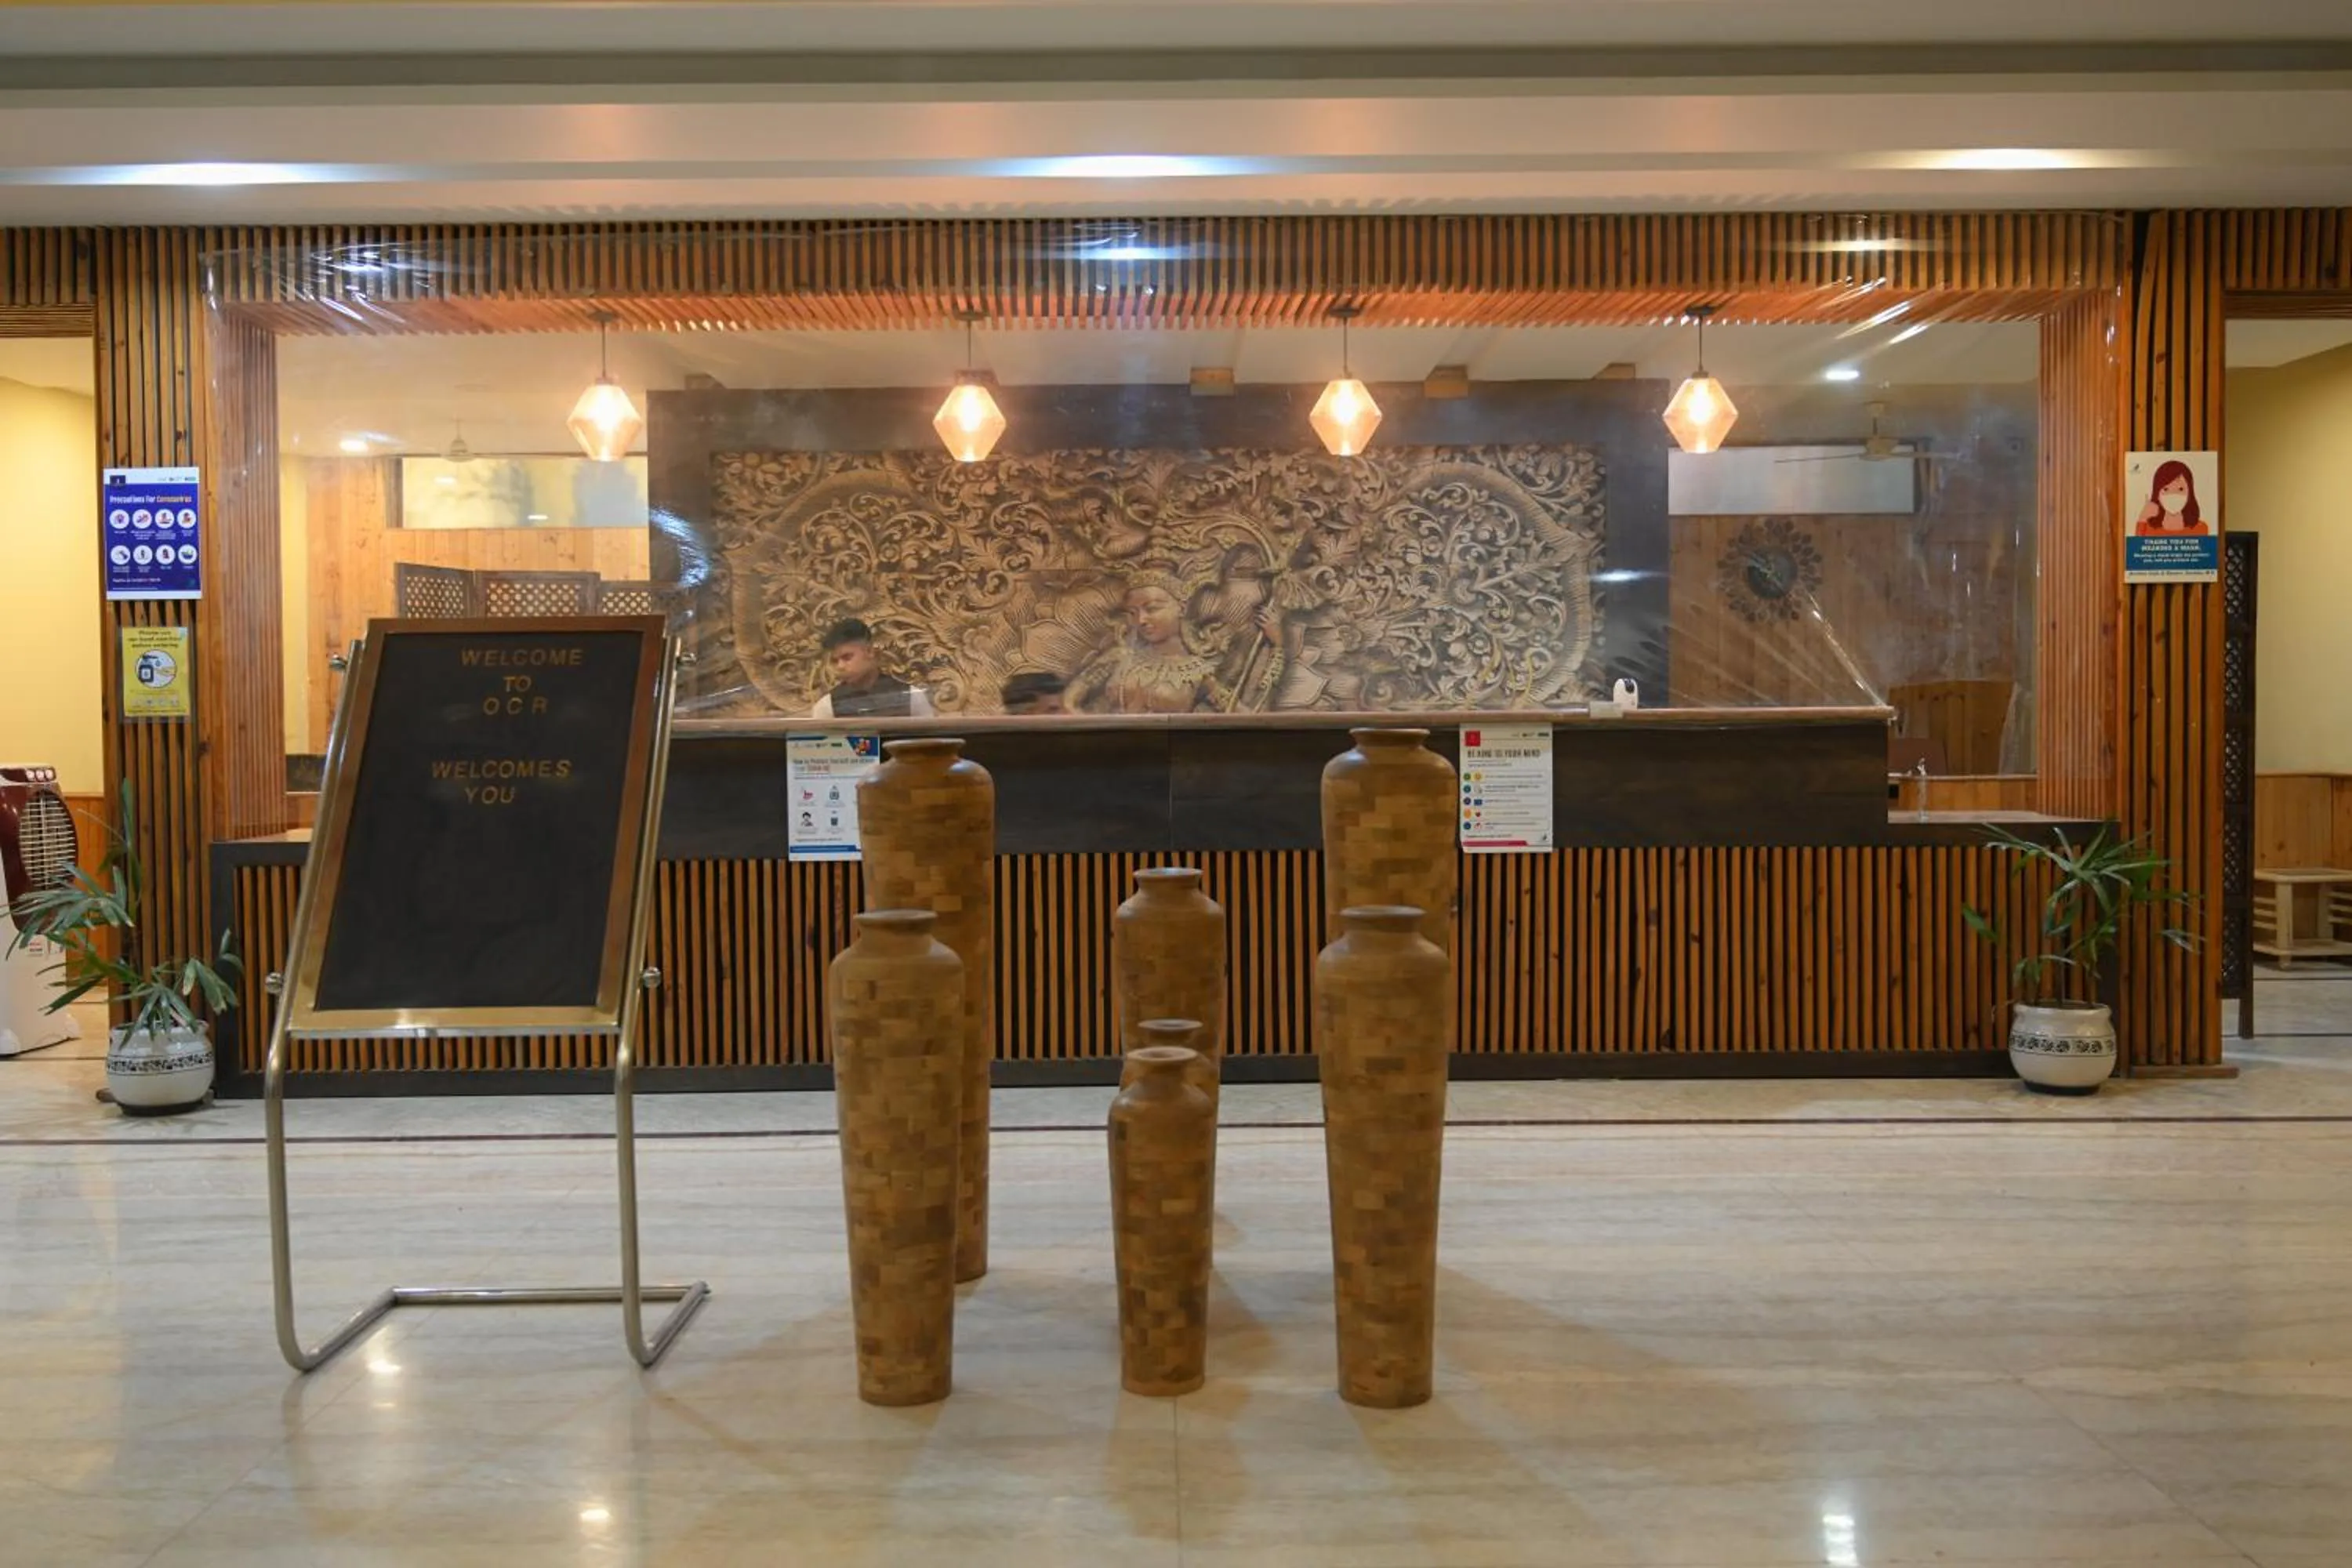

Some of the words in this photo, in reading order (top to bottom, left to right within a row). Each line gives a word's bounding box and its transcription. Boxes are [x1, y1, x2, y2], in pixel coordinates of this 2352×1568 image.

[461, 648, 584, 666] WELCOME
[503, 675, 532, 692] TO
[431, 760, 572, 779] WELCOMES
[464, 786, 516, 804] YOU
